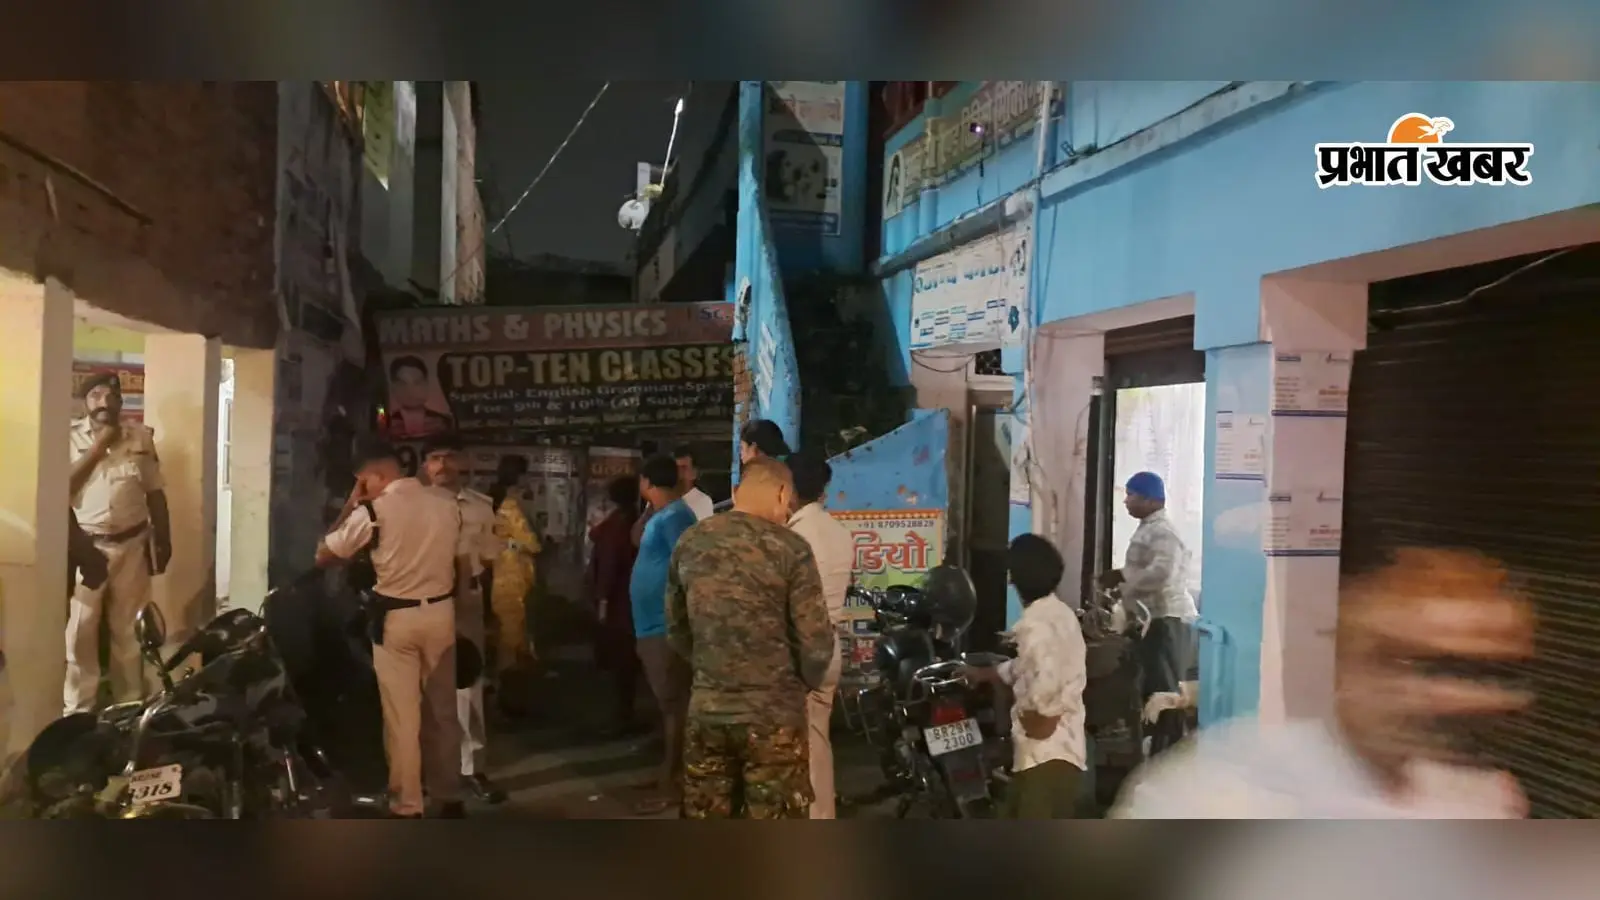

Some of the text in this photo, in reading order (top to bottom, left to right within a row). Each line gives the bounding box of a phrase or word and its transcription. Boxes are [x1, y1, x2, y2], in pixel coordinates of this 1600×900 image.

[379, 309, 667, 344] MATHS & PHYSICS
[448, 345, 735, 388] TOP-TEN CLASSES
[525, 385, 592, 401] English
[943, 732, 974, 750] 2300
